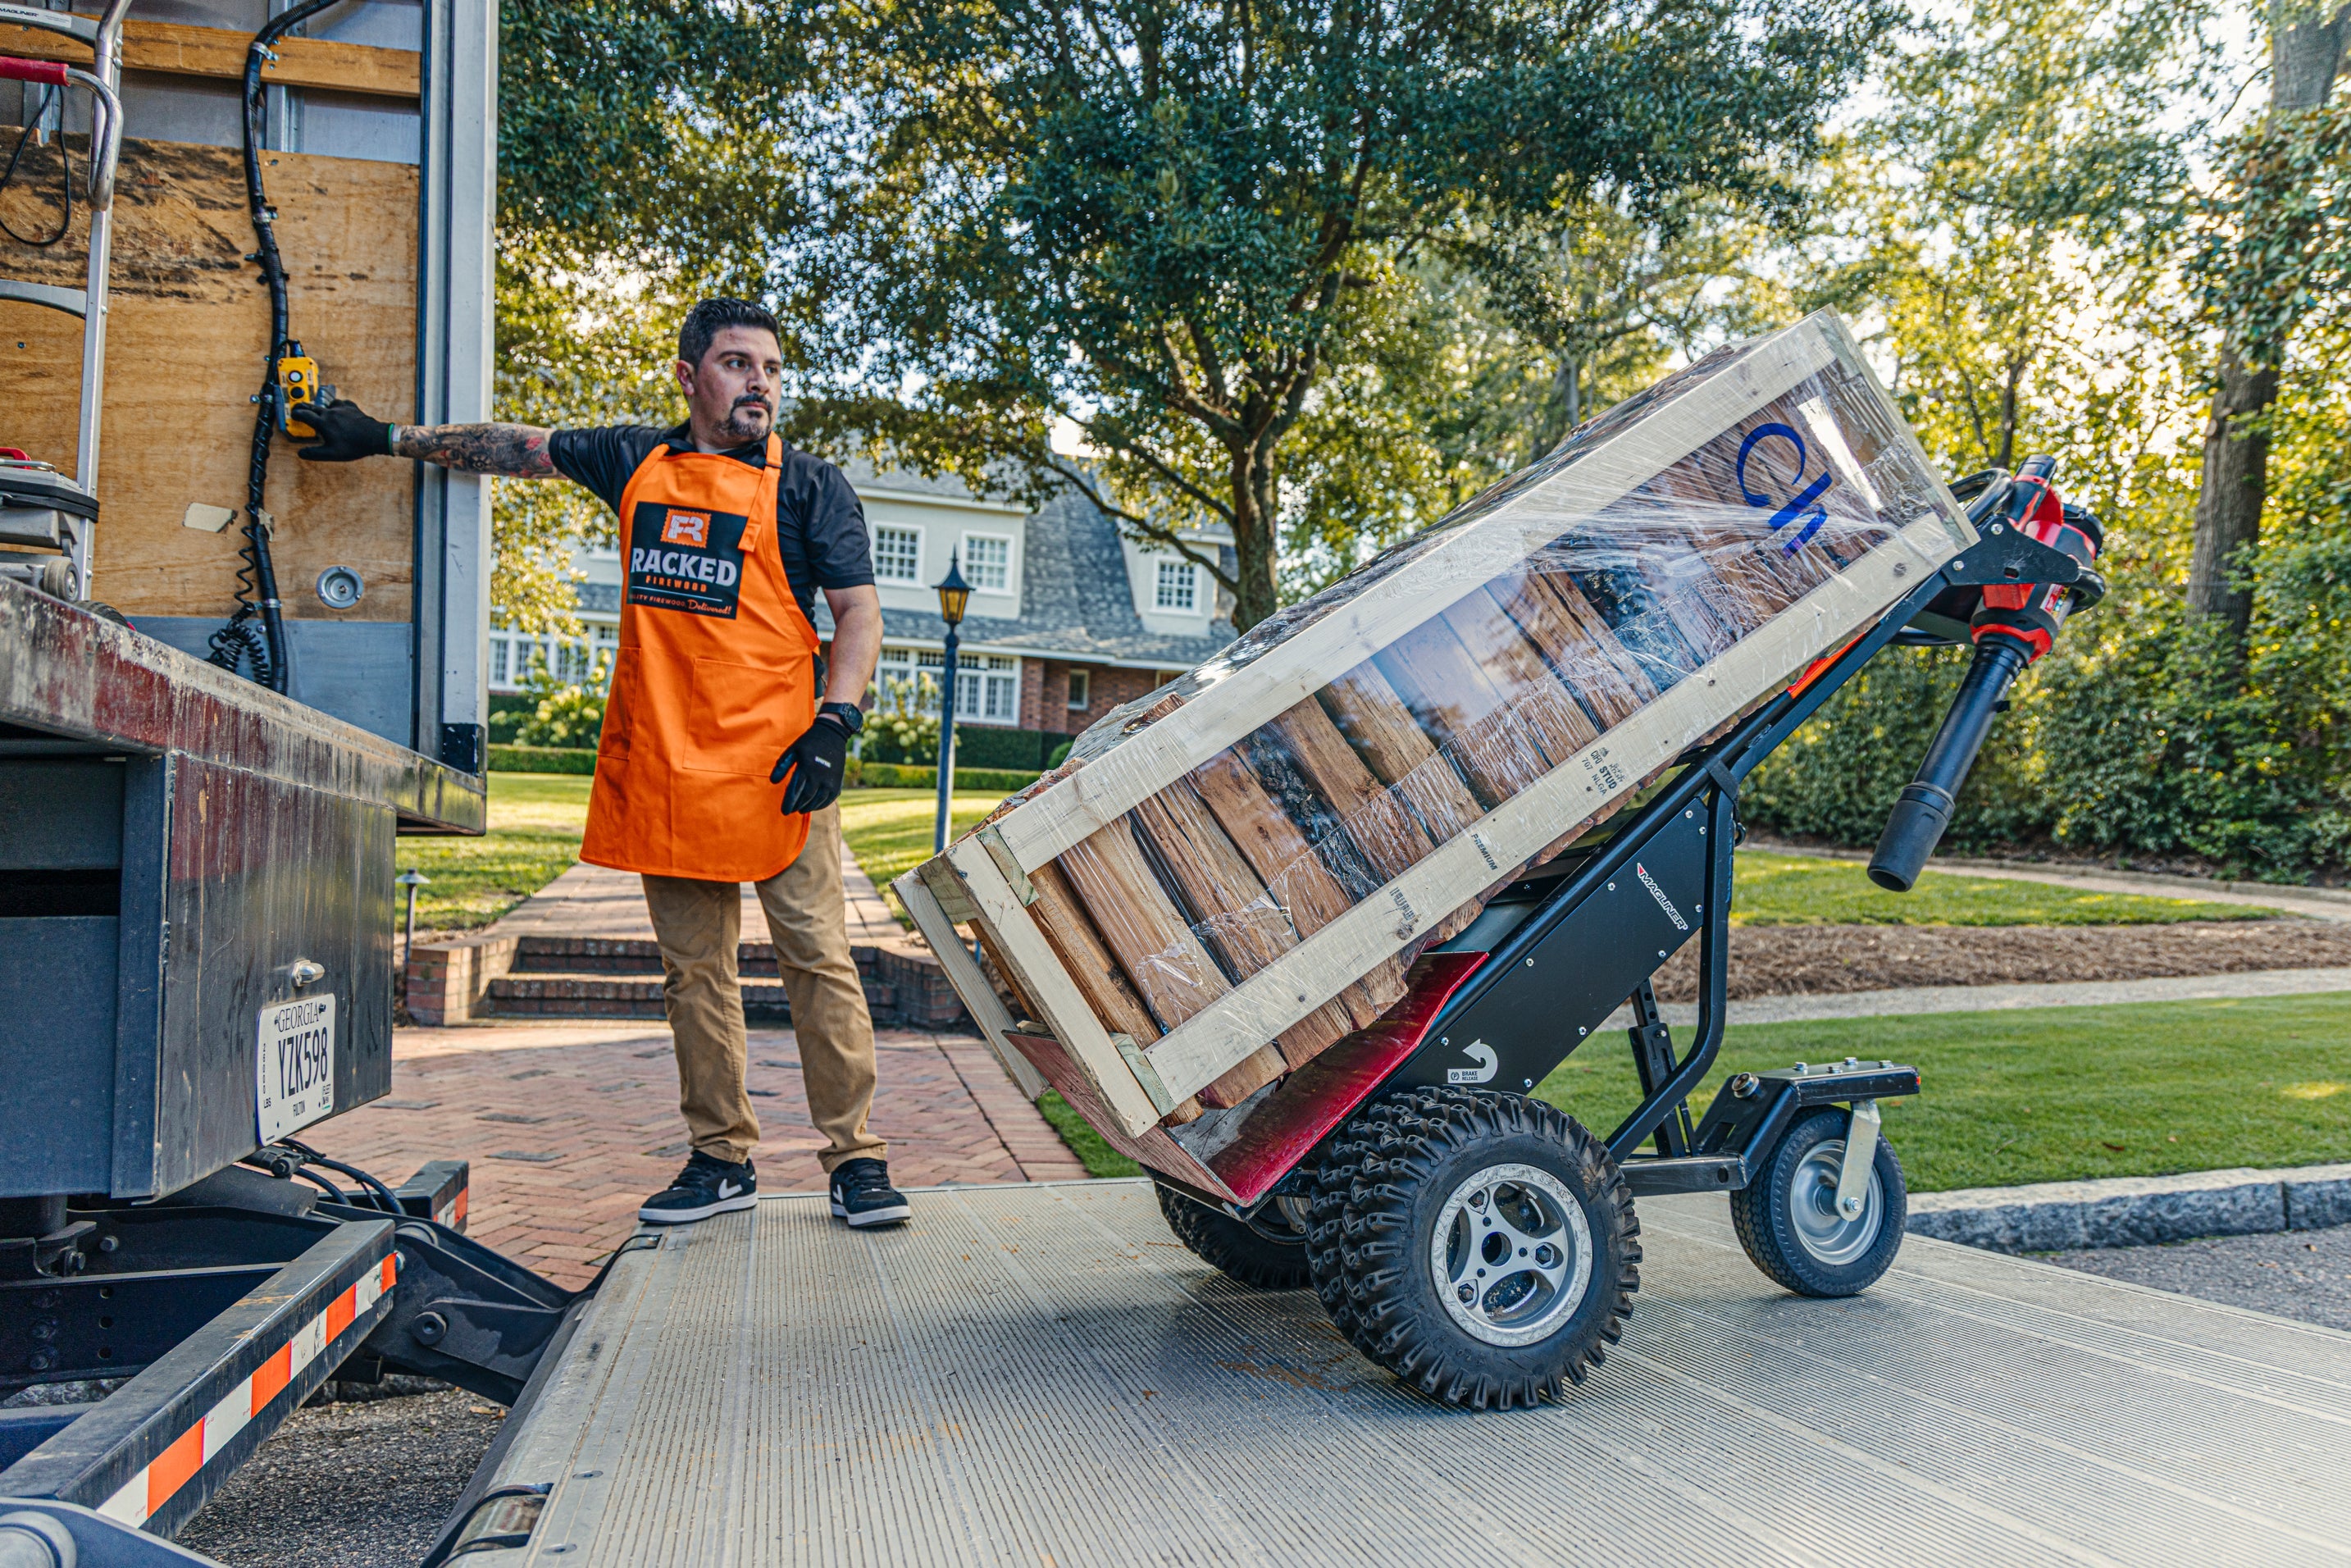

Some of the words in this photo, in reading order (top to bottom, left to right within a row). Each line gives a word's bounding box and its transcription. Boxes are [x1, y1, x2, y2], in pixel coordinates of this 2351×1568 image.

[631, 548, 737, 587] RACKED
[645, 575, 707, 592] FIREWOOD
[687, 599, 732, 615] Delivered!
[1582, 757, 1593, 770] 707
[1592, 773, 1607, 795] NLGA
[1599, 765, 1617, 790] STUD
[1471, 833, 1498, 870] PREMIUM
[1638, 872, 1687, 930] MAGLINER
[278, 1001, 319, 1032] GEORGIA
[278, 1027, 328, 1100] YZK598
[263, 1097, 271, 1109] LBS
[293, 1100, 305, 1117] FULTON
